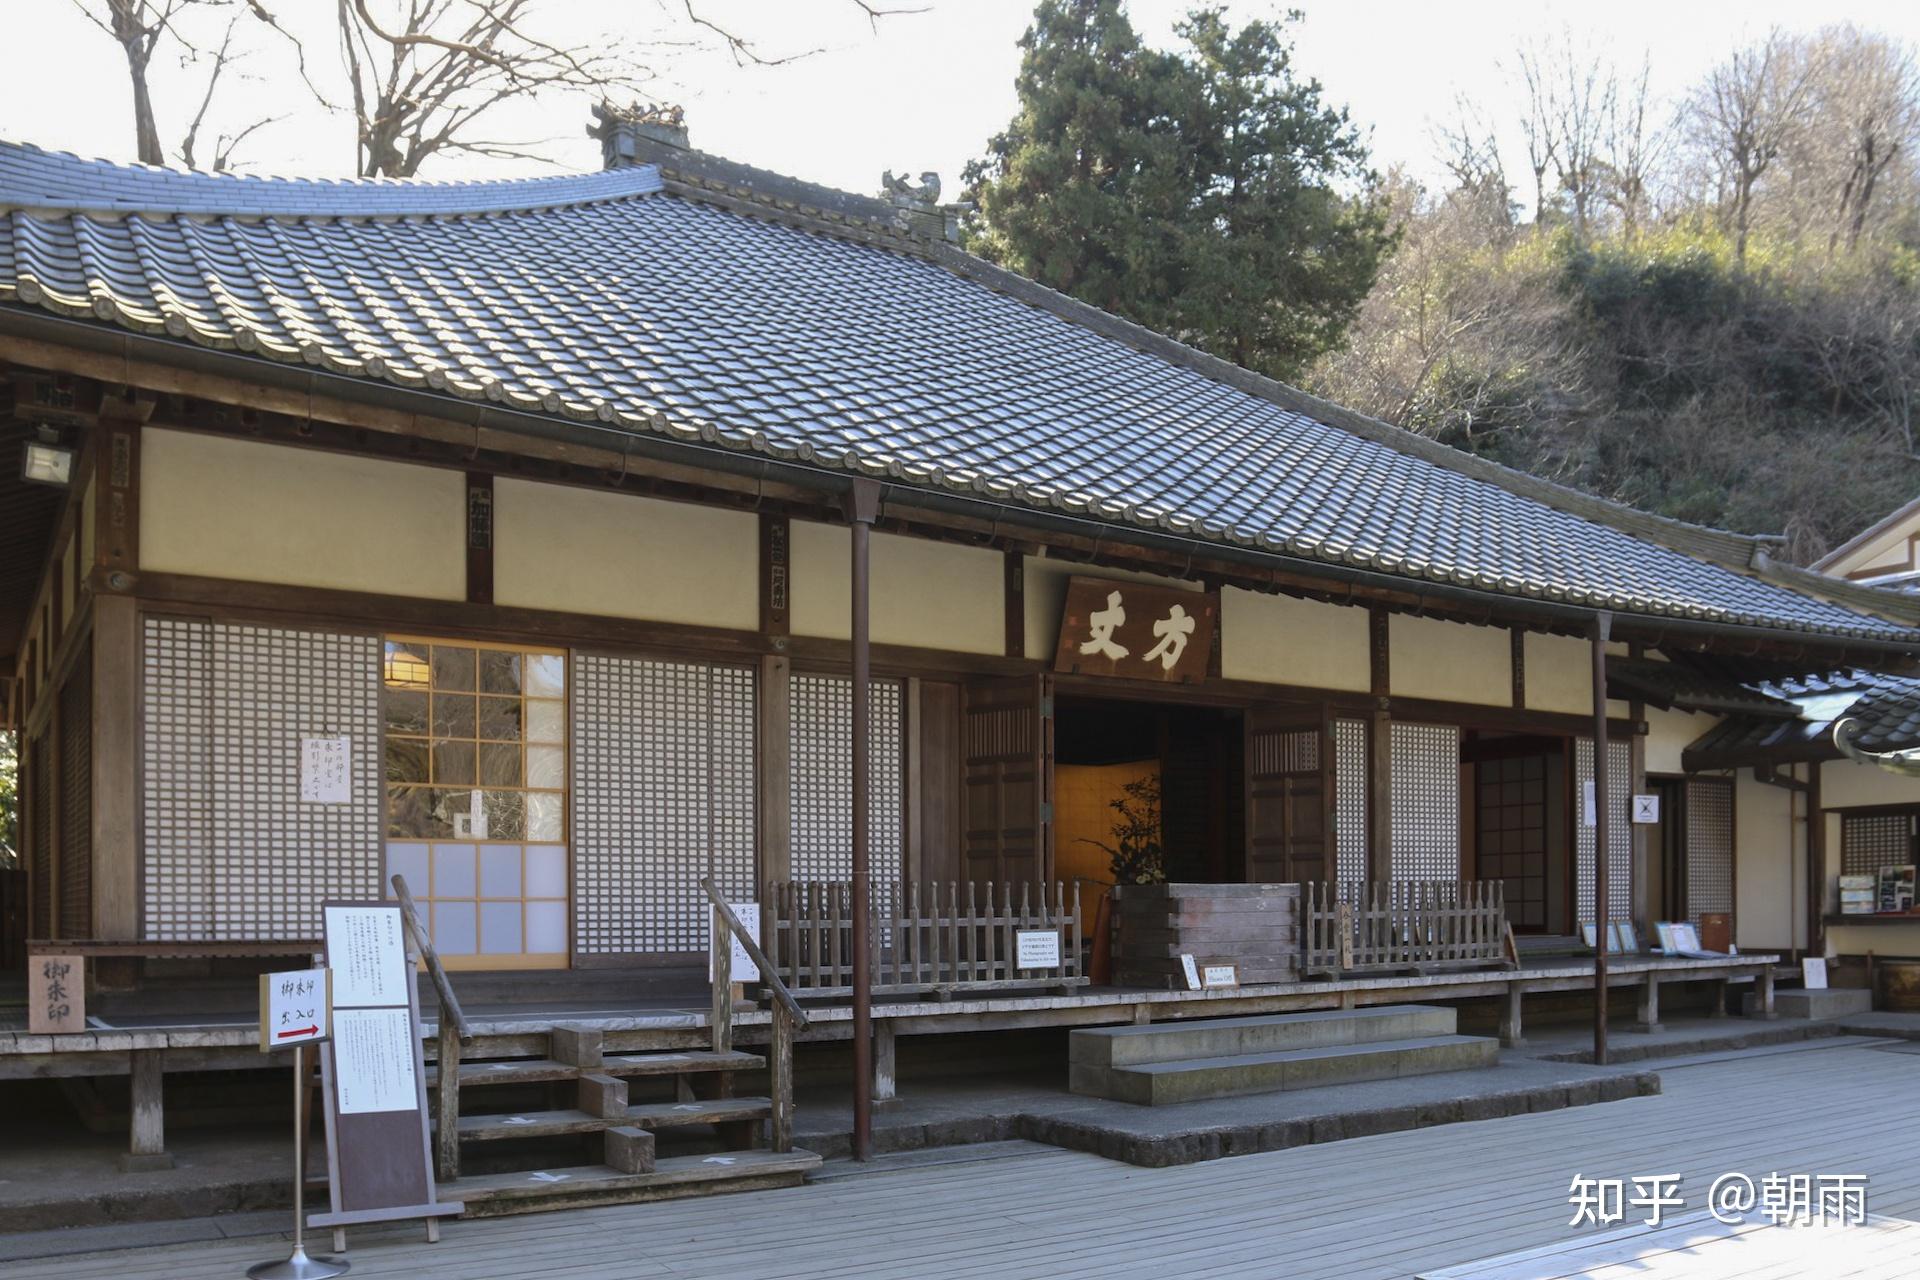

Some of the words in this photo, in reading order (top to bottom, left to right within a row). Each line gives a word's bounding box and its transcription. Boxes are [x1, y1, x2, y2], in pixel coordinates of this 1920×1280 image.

[43, 959, 71, 1024] 御朱印
[281, 977, 315, 1000] 御朱印
